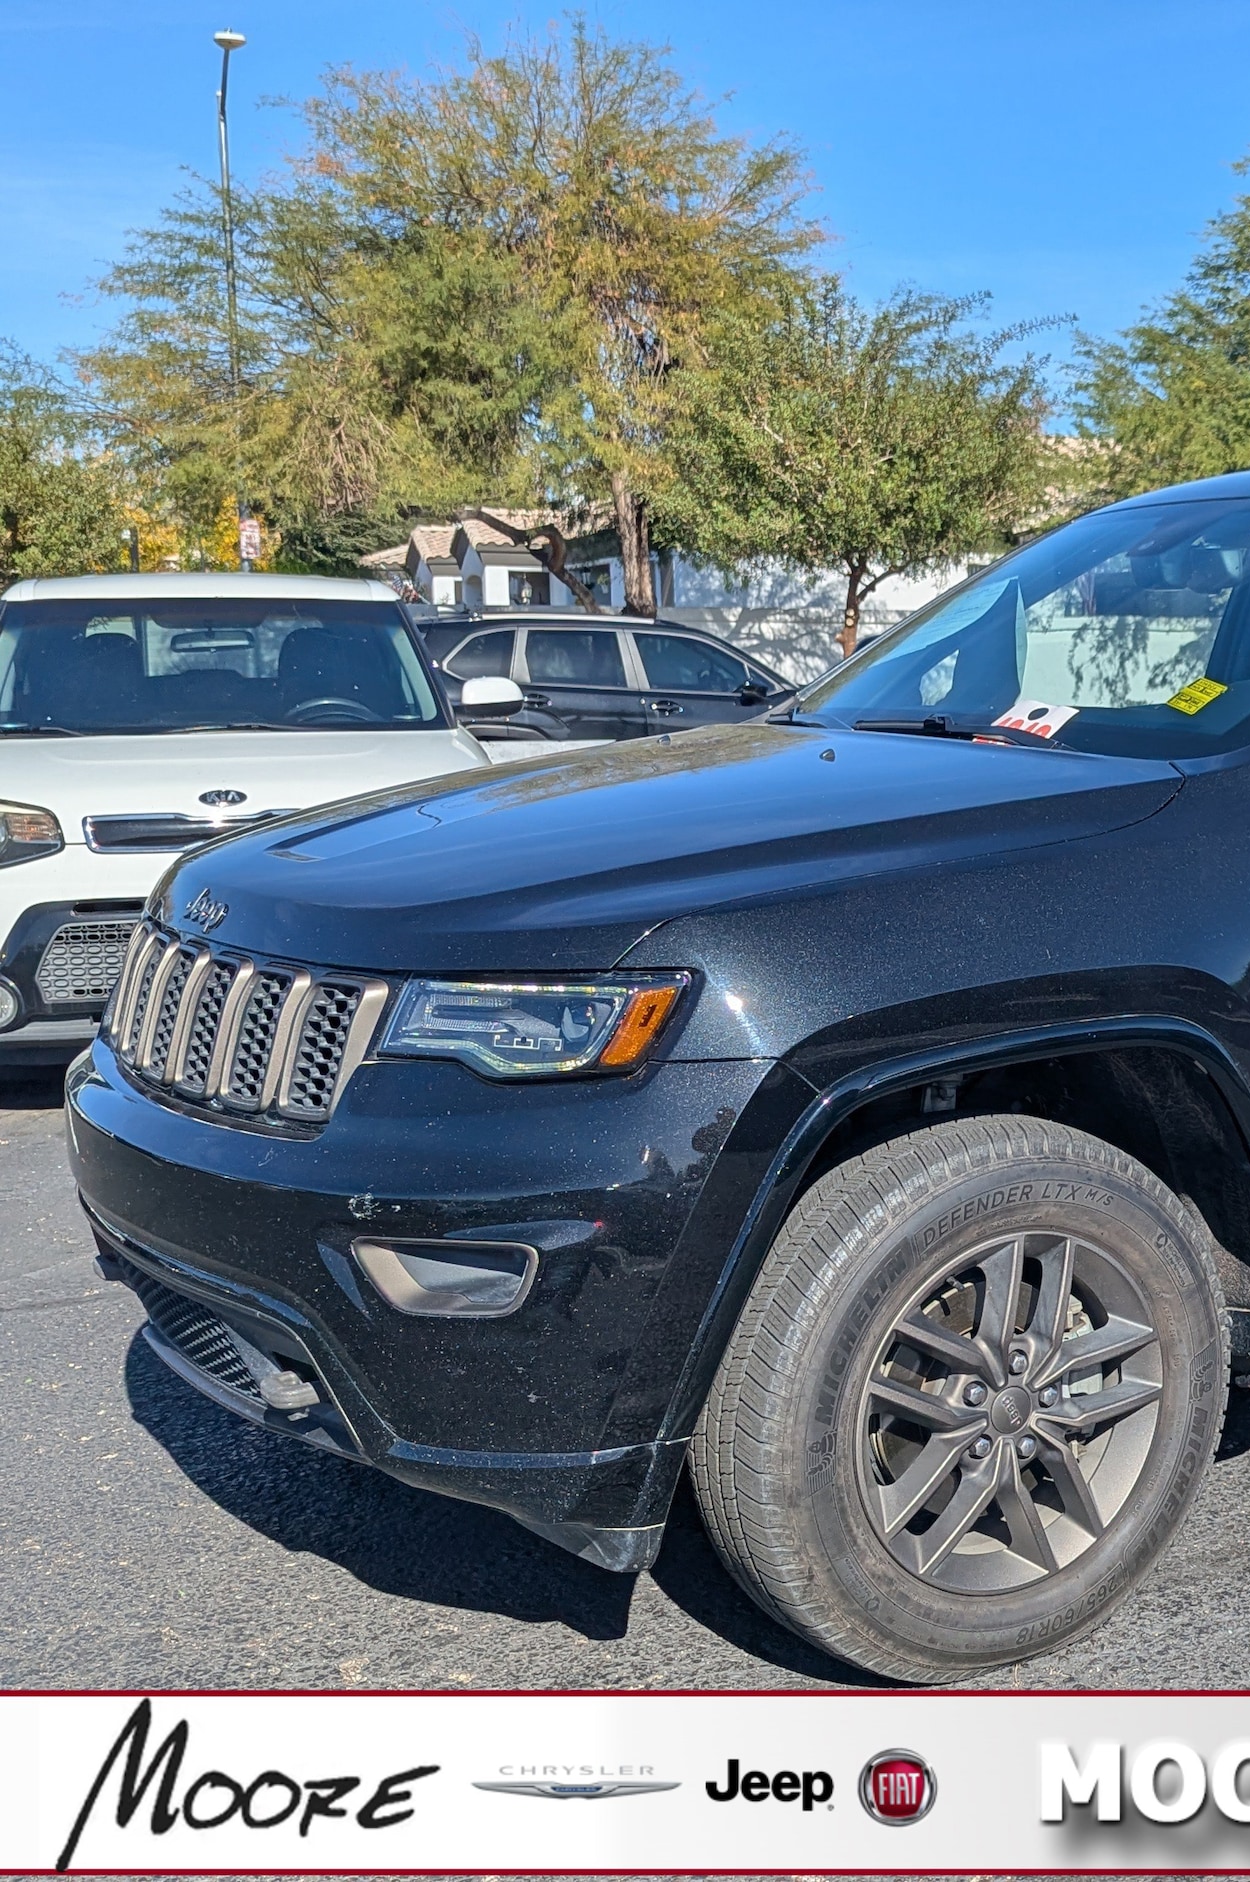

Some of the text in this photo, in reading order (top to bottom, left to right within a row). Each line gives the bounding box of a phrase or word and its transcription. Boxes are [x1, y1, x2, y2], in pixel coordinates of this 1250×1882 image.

[206, 791, 241, 803] KIA
[185, 887, 229, 934] Jeep
[922, 1184, 1034, 1248] DEFENDER
[1041, 1183, 1083, 1201] LTX
[1085, 1188, 1114, 1207] M/S
[814, 1236, 913, 1427] MICHELIN
[1130, 1406, 1208, 1569] MICHELIN
[1016, 1573, 1118, 1646] 265/60R18
